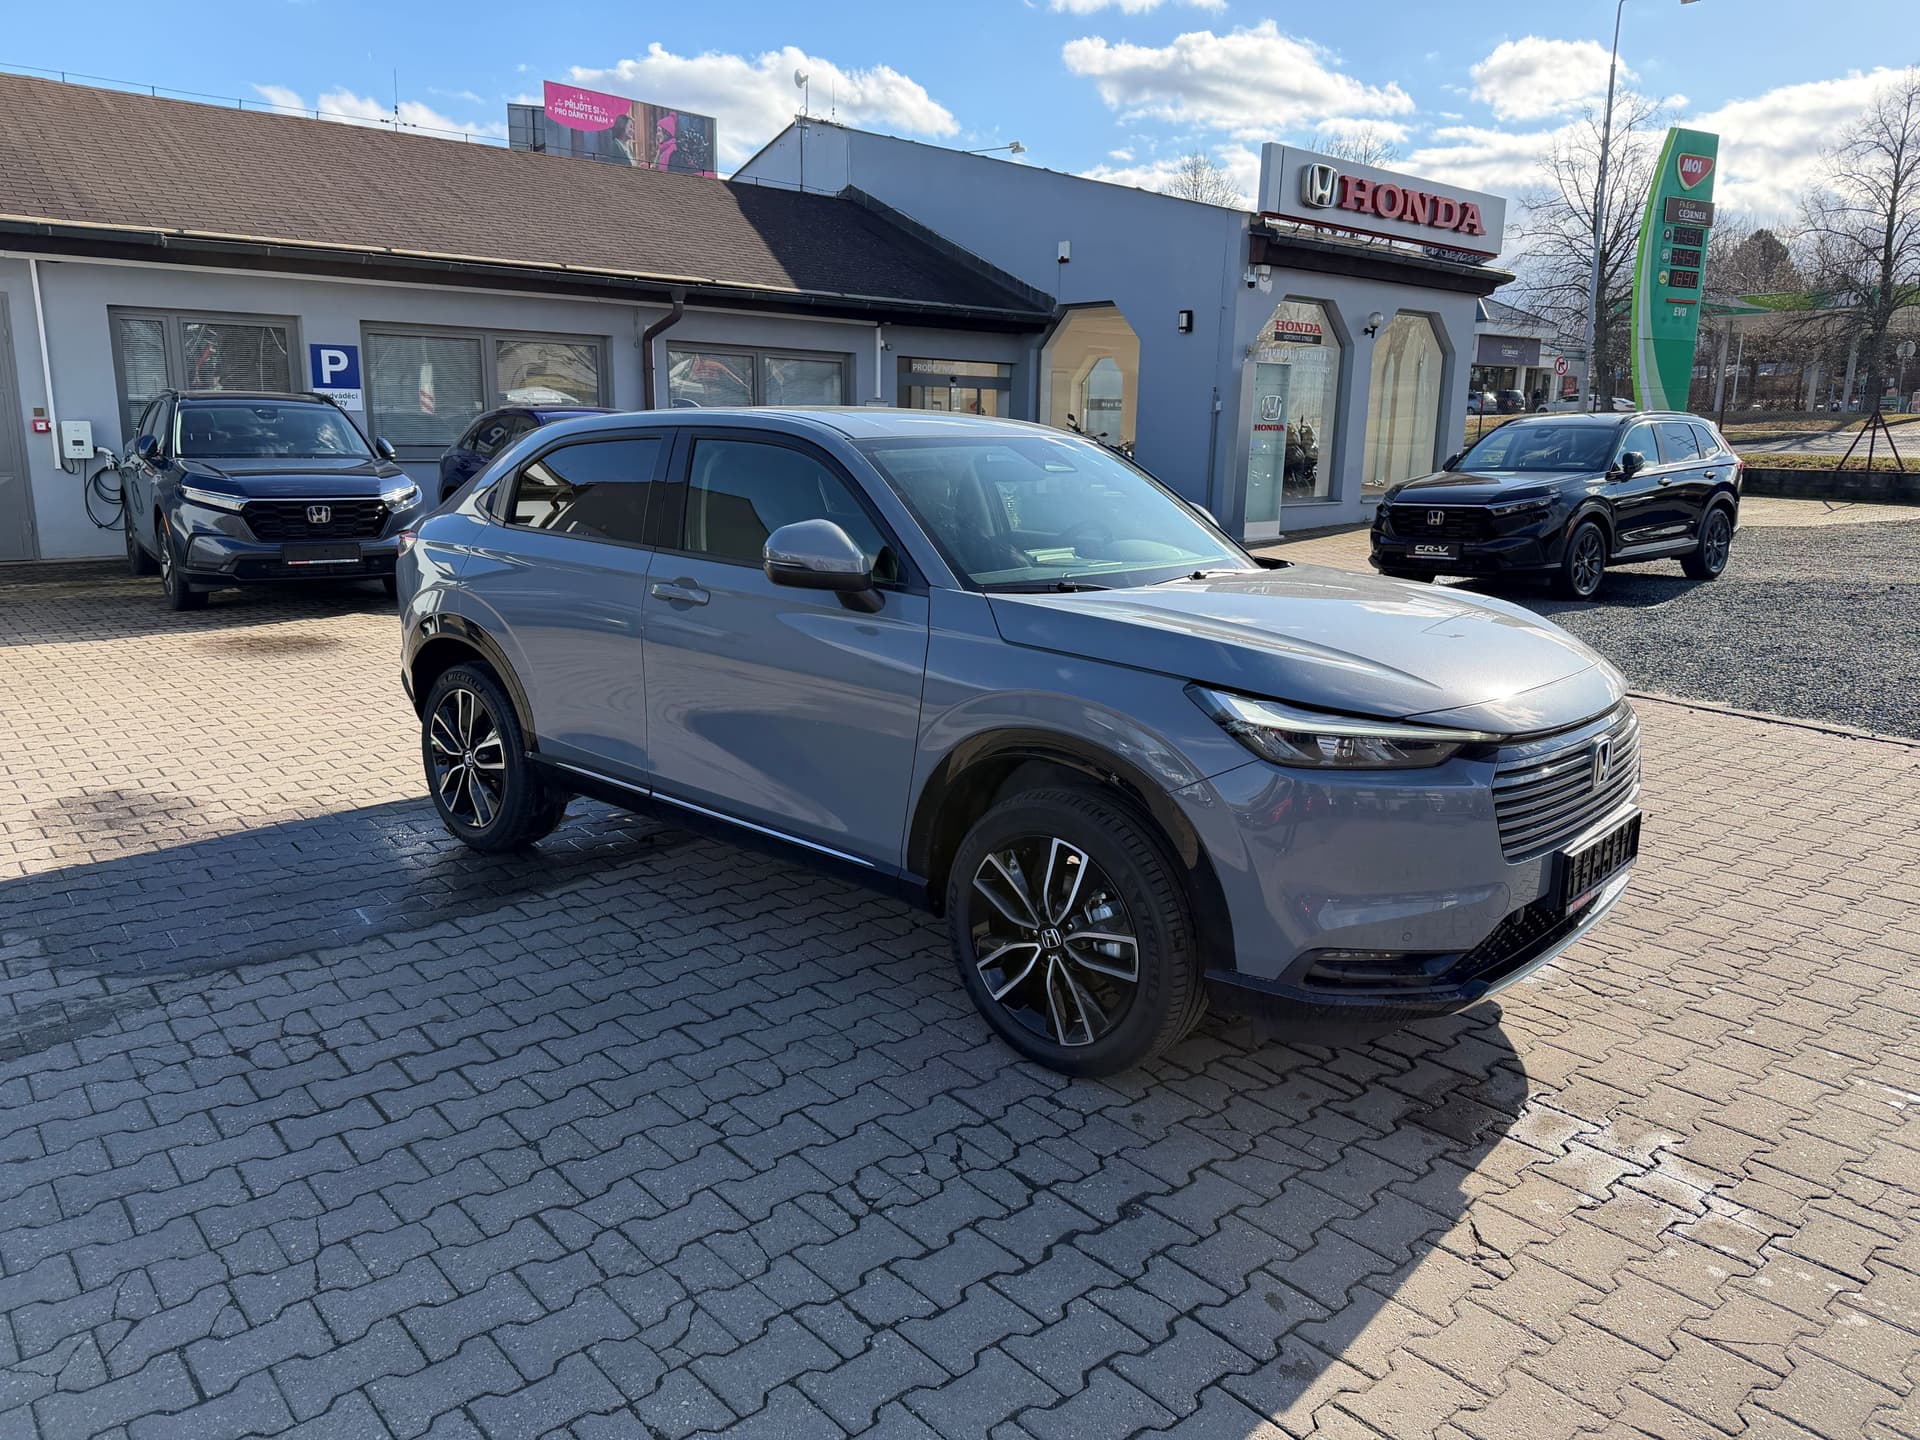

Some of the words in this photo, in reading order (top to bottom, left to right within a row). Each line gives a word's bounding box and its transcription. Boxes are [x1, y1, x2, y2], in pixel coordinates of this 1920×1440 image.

[564, 99, 592, 113] PŘIJĎTE
[592, 105, 600, 114] SI
[554, 107, 567, 116] PRO
[568, 109, 588, 120] DÁRKY
[594, 114, 608, 124] NÁM
[1682, 158, 1703, 174] MOL
[1338, 174, 1487, 236] HONDA
[1678, 209, 1707, 220] CORNER
[1673, 306, 1687, 316] EVO
[1275, 319, 1323, 334] HONDA
[320, 349, 348, 384] P
[1415, 544, 1449, 552] CR-V
